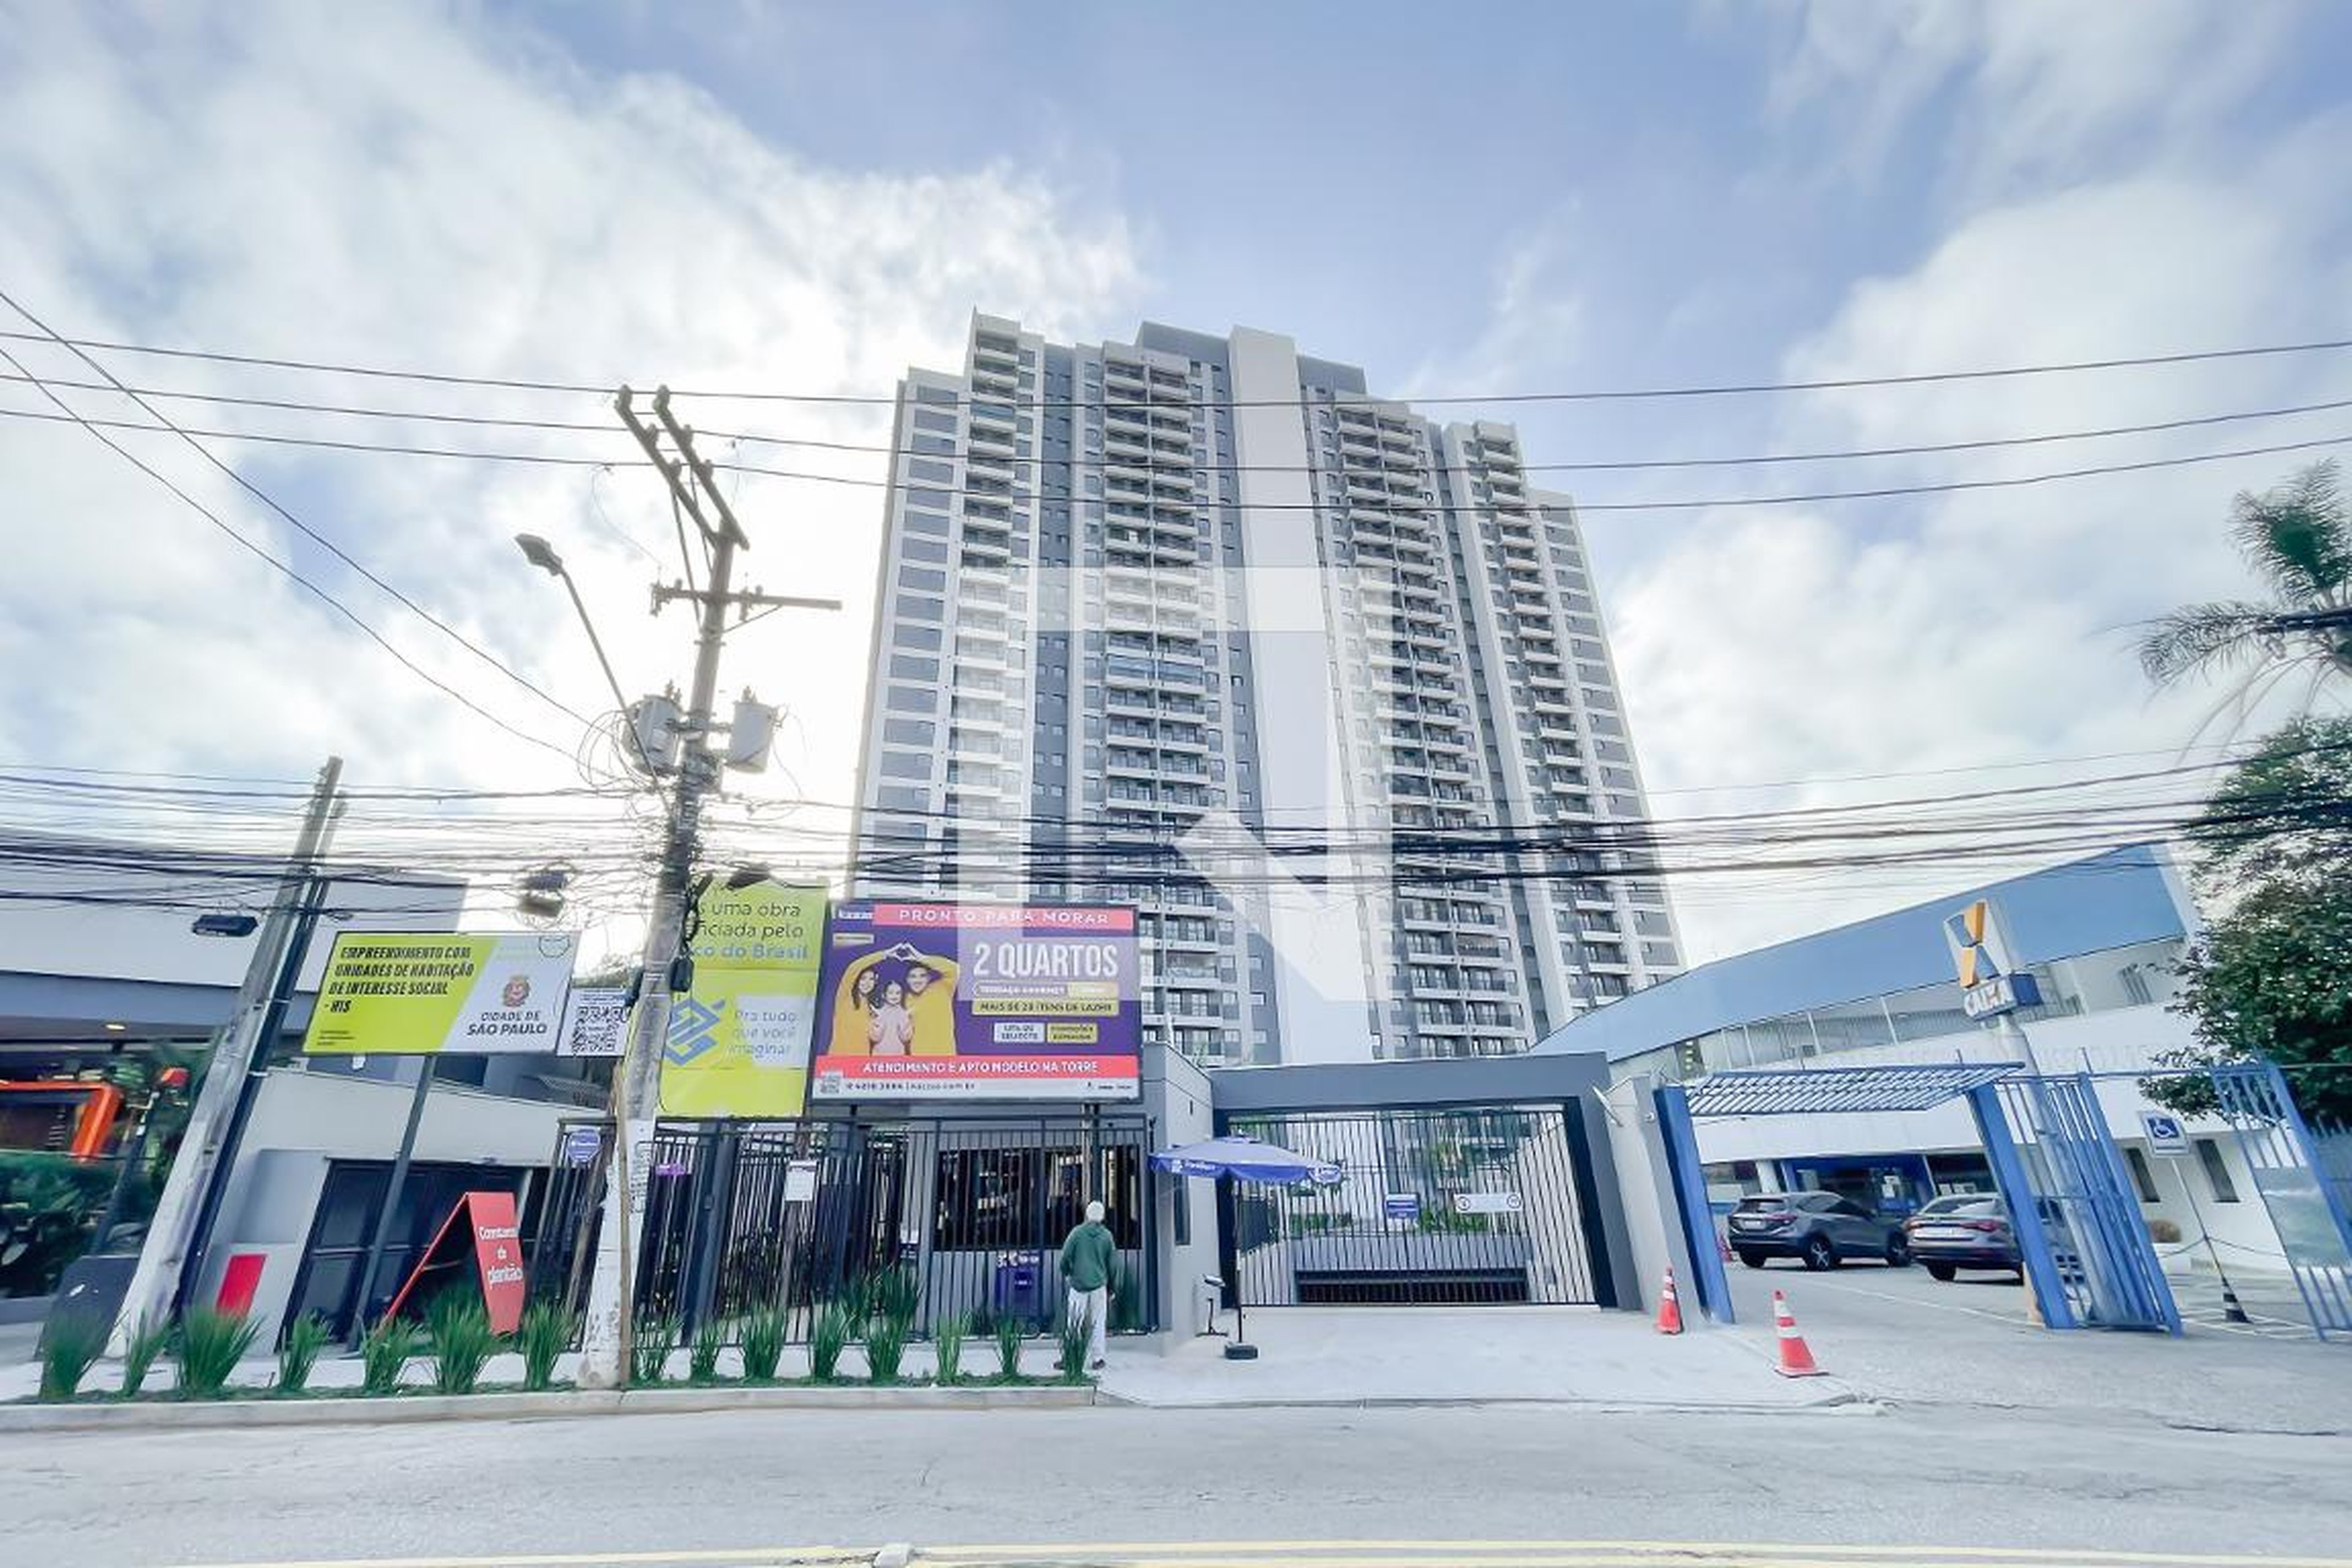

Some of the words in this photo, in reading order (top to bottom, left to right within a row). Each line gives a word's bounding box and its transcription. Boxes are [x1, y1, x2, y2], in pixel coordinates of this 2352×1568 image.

[712, 903, 752, 916] uma
[758, 902, 801, 917] obra
[900, 910, 977, 921] PRONTO
[986, 911, 1033, 922] PARA
[1043, 912, 1109, 924] MORAR
[763, 924, 804, 941] pelo
[340, 947, 443, 959] EMPREENDIMENTO
[445, 947, 471, 959] COM
[722, 944, 747, 957] do
[752, 944, 808, 959] Brasil
[973, 943, 991, 977] 2
[998, 943, 1118, 978] QUARTOS
[334, 963, 393, 977] UNIDADES
[394, 964, 409, 976] DE
[410, 961, 474, 980] HABITAÇÃO
[328, 982, 344, 995] DE
[345, 982, 407, 995] INTERESSE
[408, 982, 448, 995] SOCIAL
[1964, 979, 2015, 1017] CAIXA
[330, 1000, 352, 1013] HIS
[481, 1011, 521, 1022] CIDADE
[524, 1010, 540, 1021] DE
[735, 1010, 758, 1022] Pra
[763, 1009, 795, 1022] tudo
[500, 1022, 548, 1035] PAULO
[863, 1062, 946, 1073] ATENDIMENTO
[948, 1063, 956, 1072] E
[958, 1062, 990, 1072] APTO
[992, 1061, 1040, 1072] MODELO
[1042, 1061, 1058, 1072] NA
[1061, 1061, 1098, 1072] TORRE
